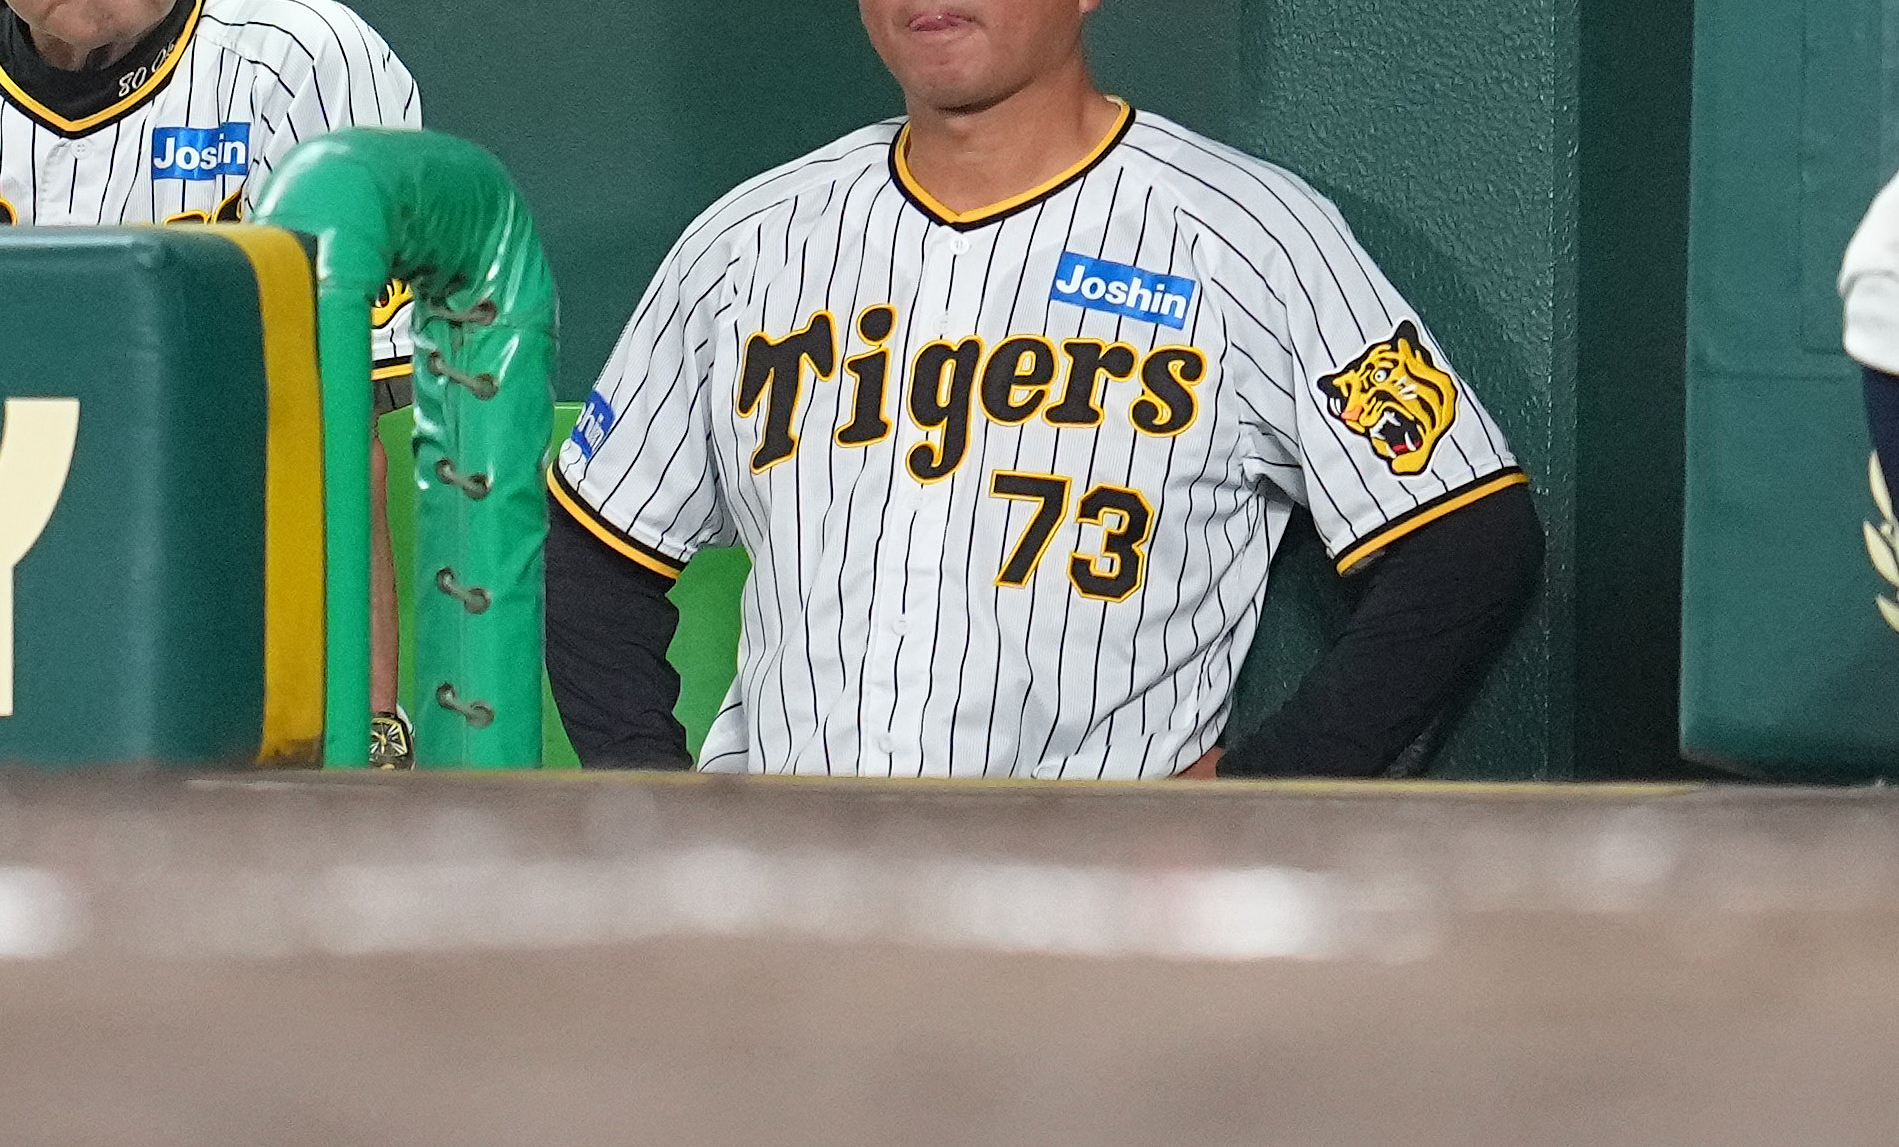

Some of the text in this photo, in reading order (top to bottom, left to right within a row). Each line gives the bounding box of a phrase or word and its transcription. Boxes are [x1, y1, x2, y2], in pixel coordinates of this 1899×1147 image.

[1056, 263, 1187, 321] Joshin
[735, 302, 1207, 485] Tigers
[989, 468, 1155, 603] 73
